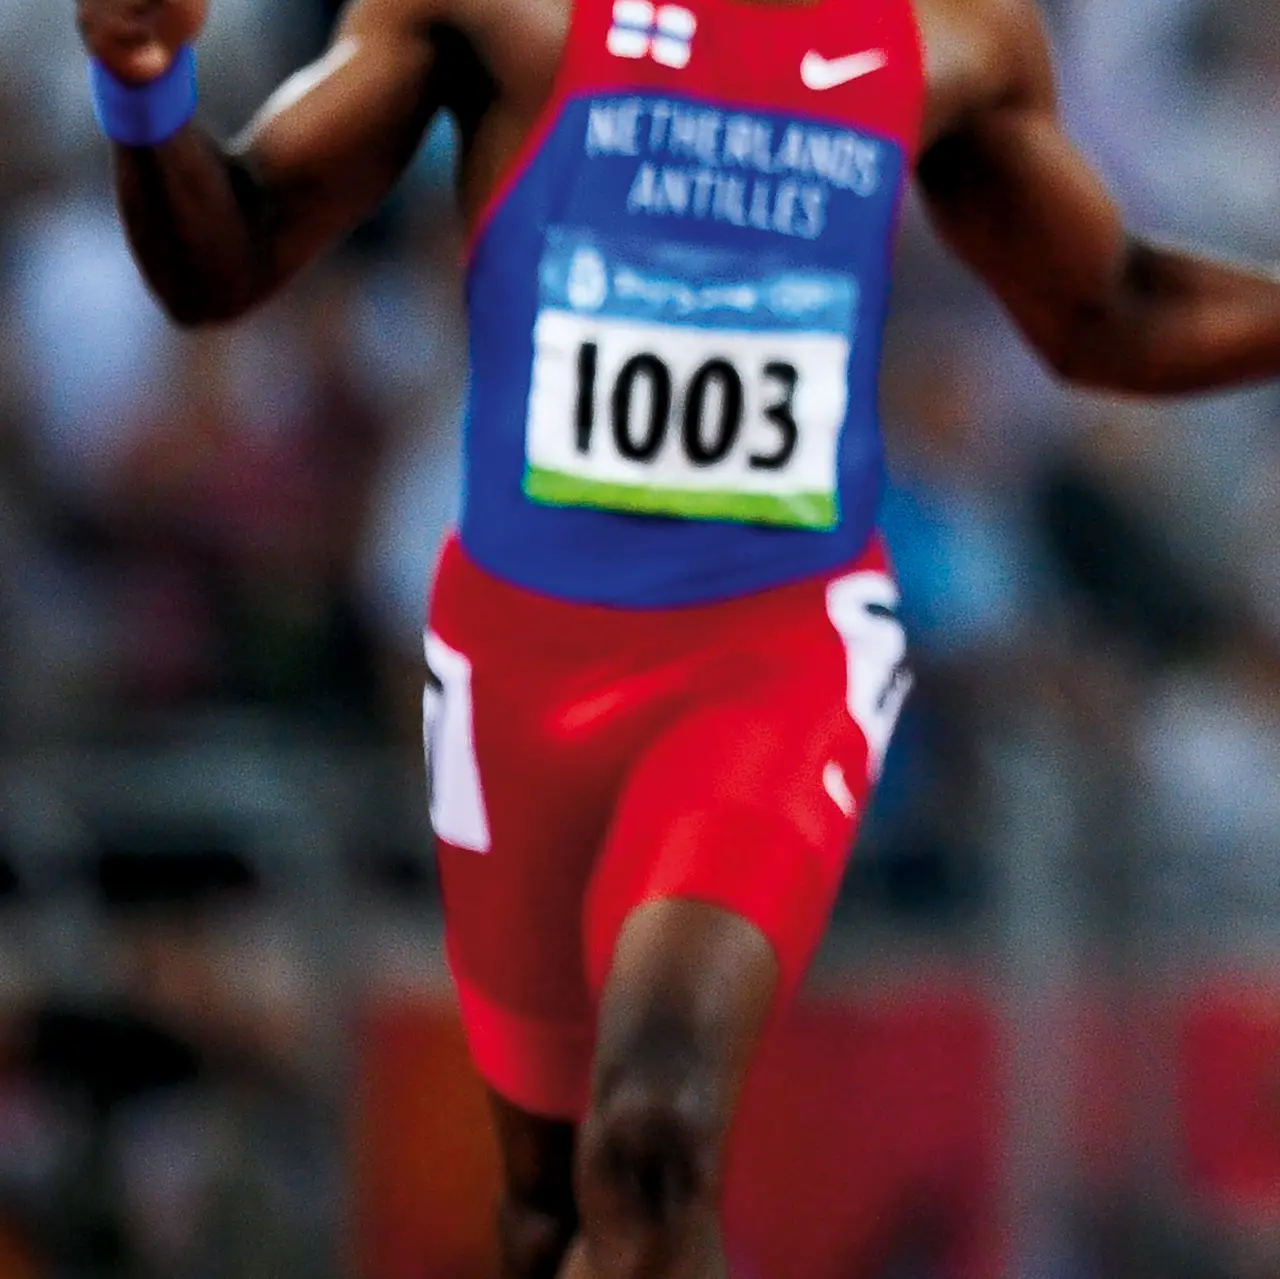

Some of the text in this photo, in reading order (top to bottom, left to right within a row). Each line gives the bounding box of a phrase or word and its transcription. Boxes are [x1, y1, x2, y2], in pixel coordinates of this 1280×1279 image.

[586, 96, 882, 196] NETHERLANDS
[628, 162, 828, 239] ANTILLES
[572, 340, 802, 471] 1003
